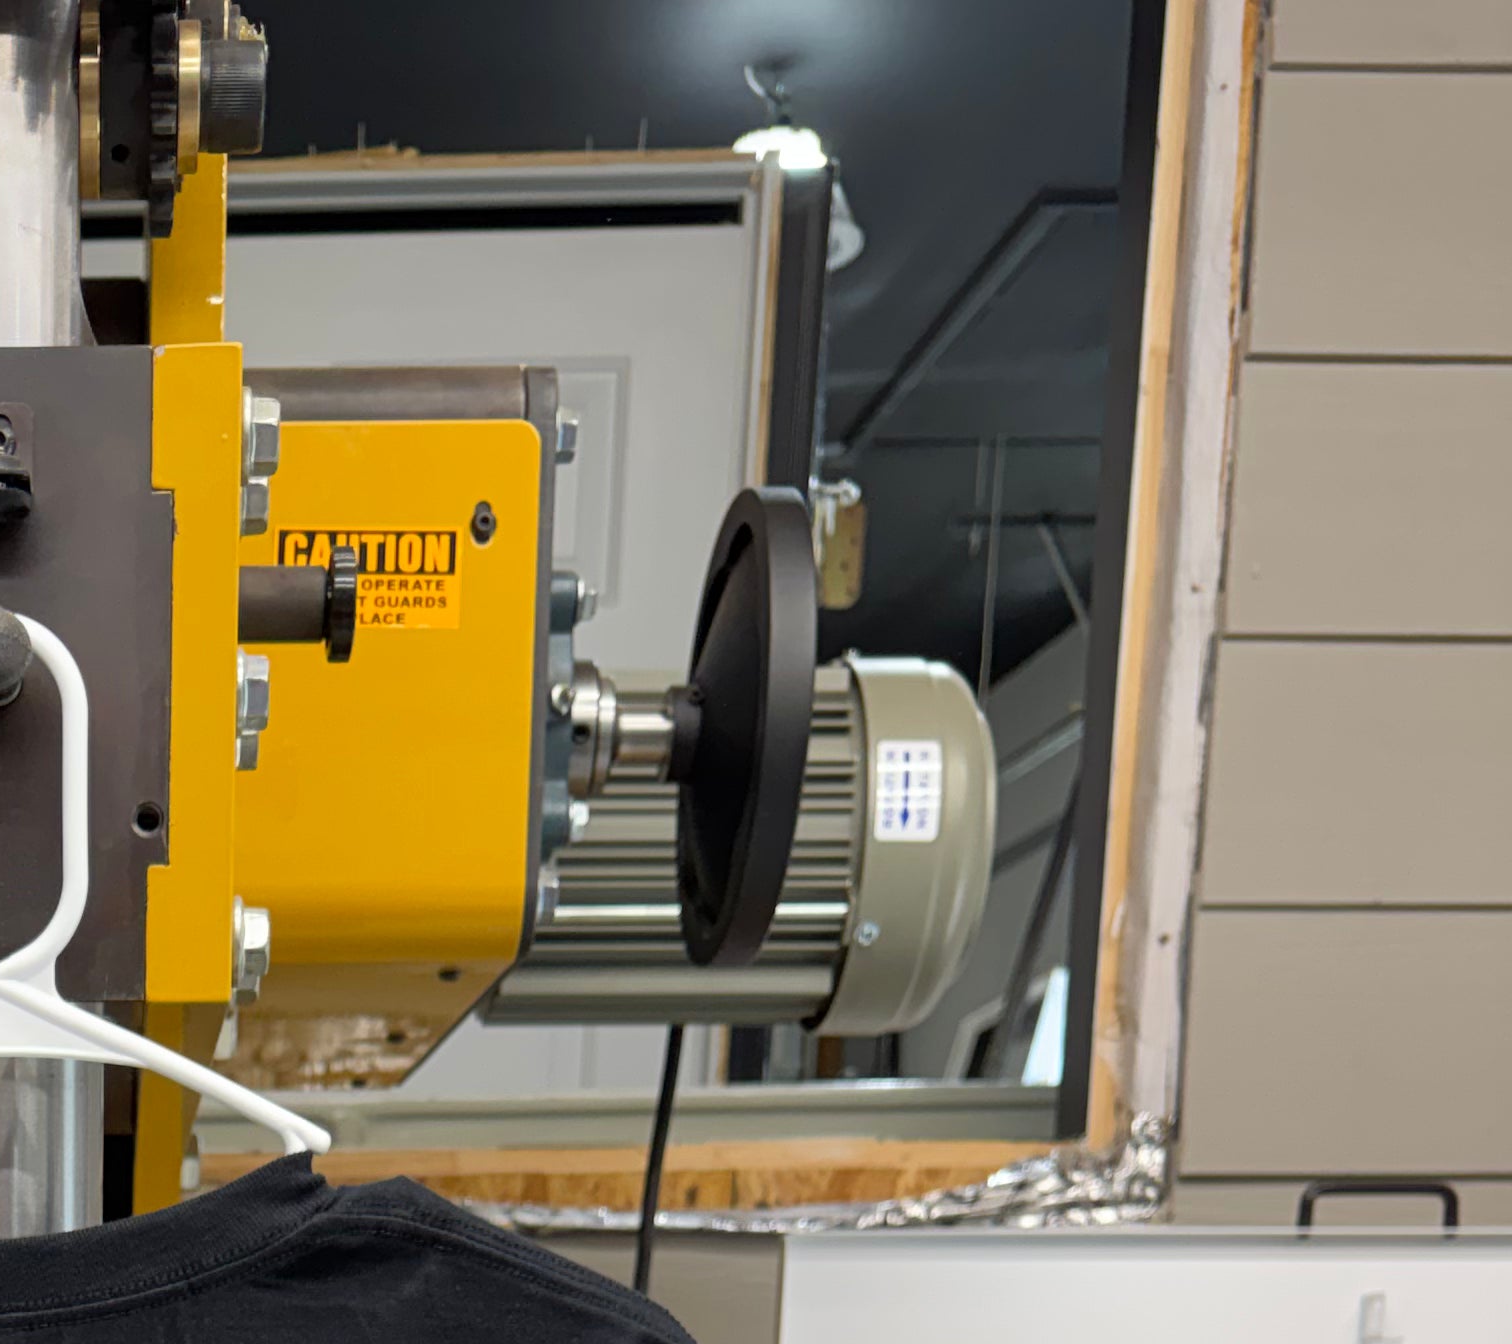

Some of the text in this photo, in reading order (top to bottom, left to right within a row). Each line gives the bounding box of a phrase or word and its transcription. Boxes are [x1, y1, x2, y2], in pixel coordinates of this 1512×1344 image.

[360, 579, 446, 592] OPERATE
[373, 595, 448, 609] GUARDS
[356, 612, 406, 626] LACE
